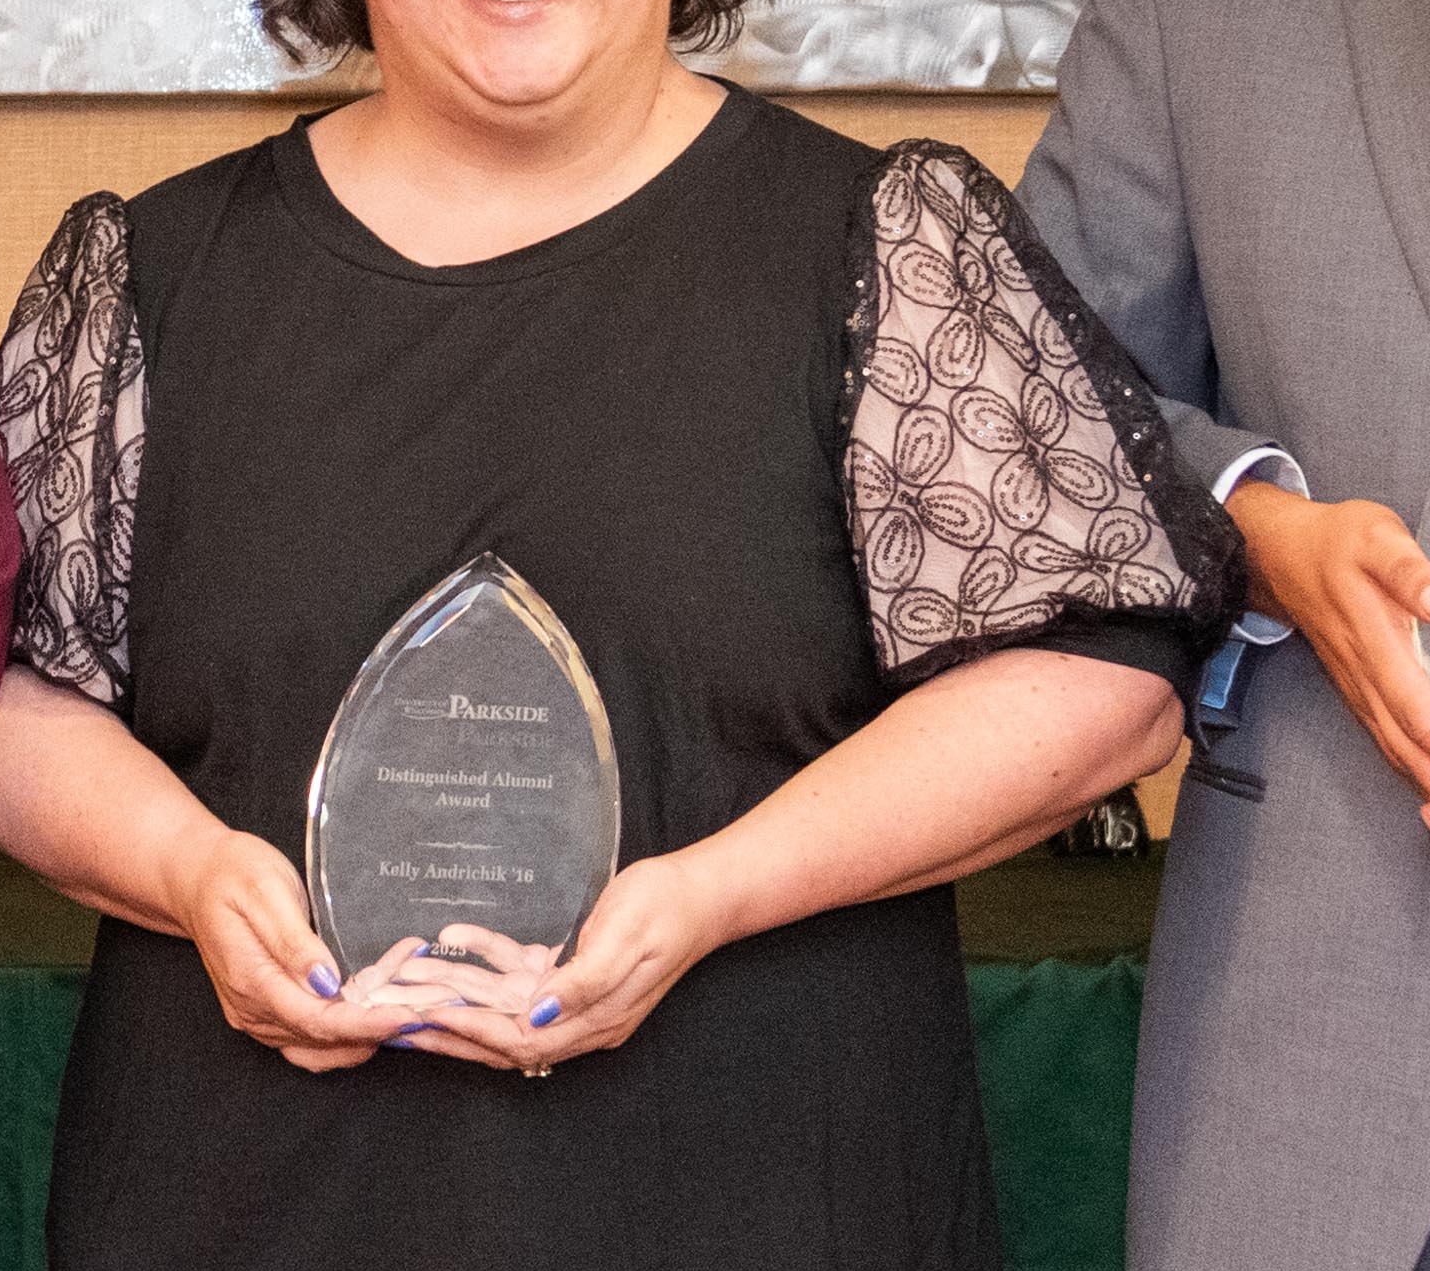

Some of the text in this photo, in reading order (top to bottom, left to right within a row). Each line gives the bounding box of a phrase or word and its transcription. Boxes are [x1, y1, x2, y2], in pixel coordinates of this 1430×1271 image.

[447, 694, 550, 723] PARKSIDE
[376, 766, 554, 789] Distinguished Alumni
[434, 792, 491, 808] Award
[378, 860, 421, 881] Kelly
[424, 862, 507, 882] Andrichik
